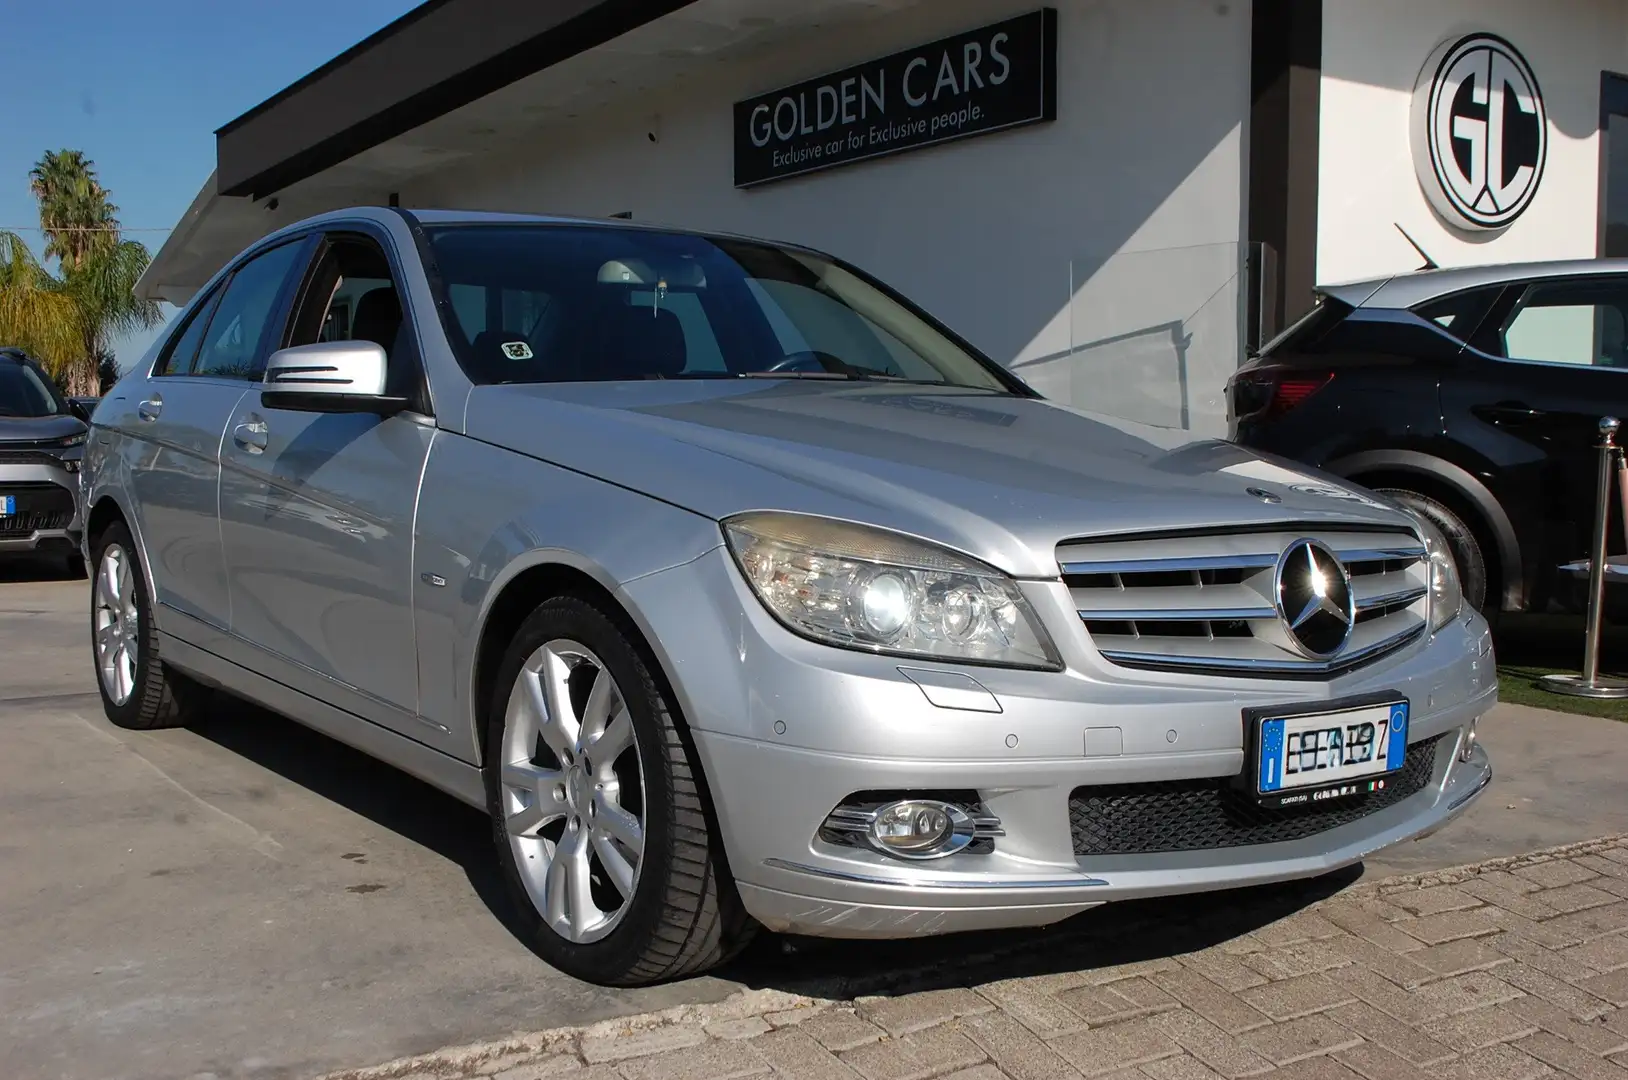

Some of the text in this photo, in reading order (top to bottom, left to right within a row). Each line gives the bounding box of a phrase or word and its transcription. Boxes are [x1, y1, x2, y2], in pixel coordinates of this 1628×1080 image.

[750, 31, 1010, 147] GOLDEN CARS
[773, 101, 985, 167] Exclusive car for Exclusive people.
